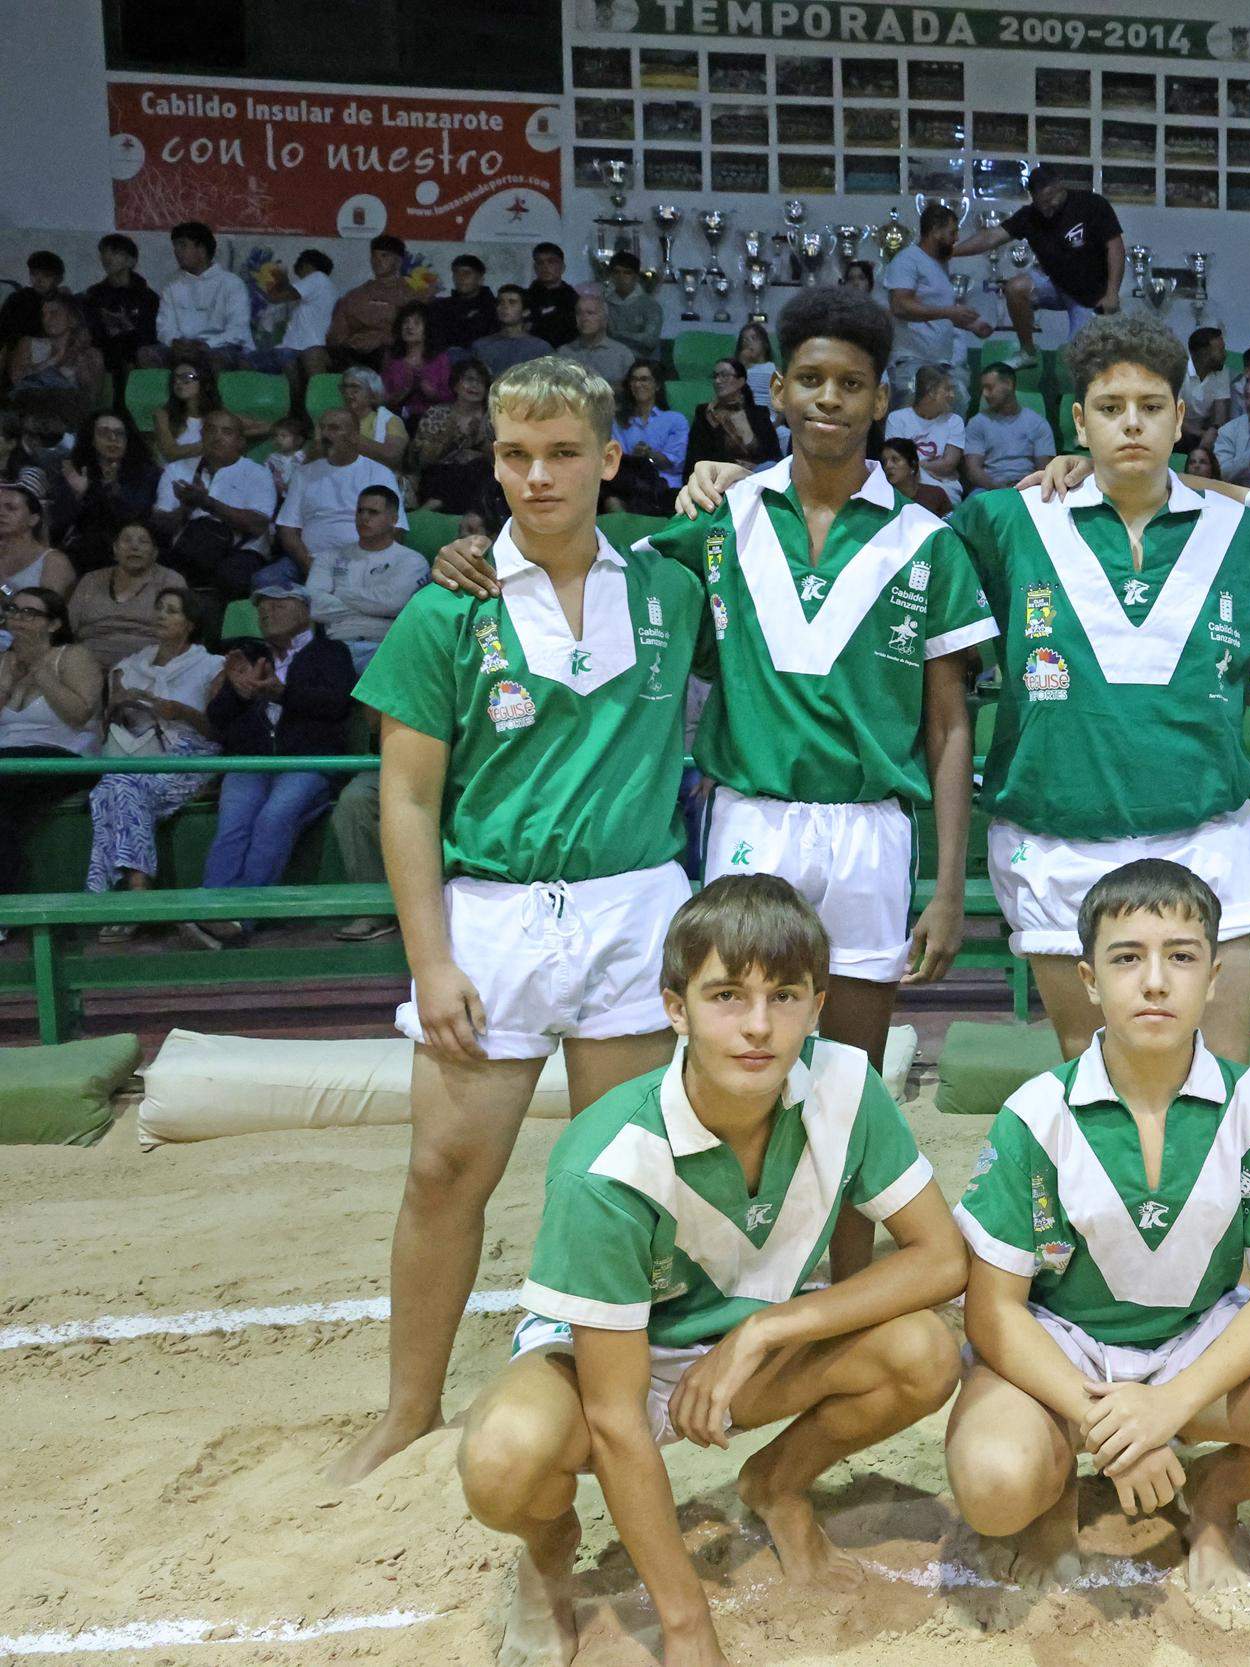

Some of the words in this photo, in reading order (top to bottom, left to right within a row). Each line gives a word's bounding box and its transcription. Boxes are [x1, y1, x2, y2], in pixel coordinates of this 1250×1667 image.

[656, 0, 977, 45] TEMPORADA
[1000, 15, 1190, 55] 2009-2014
[141, 91, 237, 119] Cabildo
[247, 97, 333, 123] Insular
[343, 102, 373, 125] de
[382, 104, 503, 131] Lanzarote
[161, 136, 245, 168] con
[265, 123, 304, 171] lo
[327, 129, 503, 176] nuestro
[891, 586, 924, 603] Cabildo
